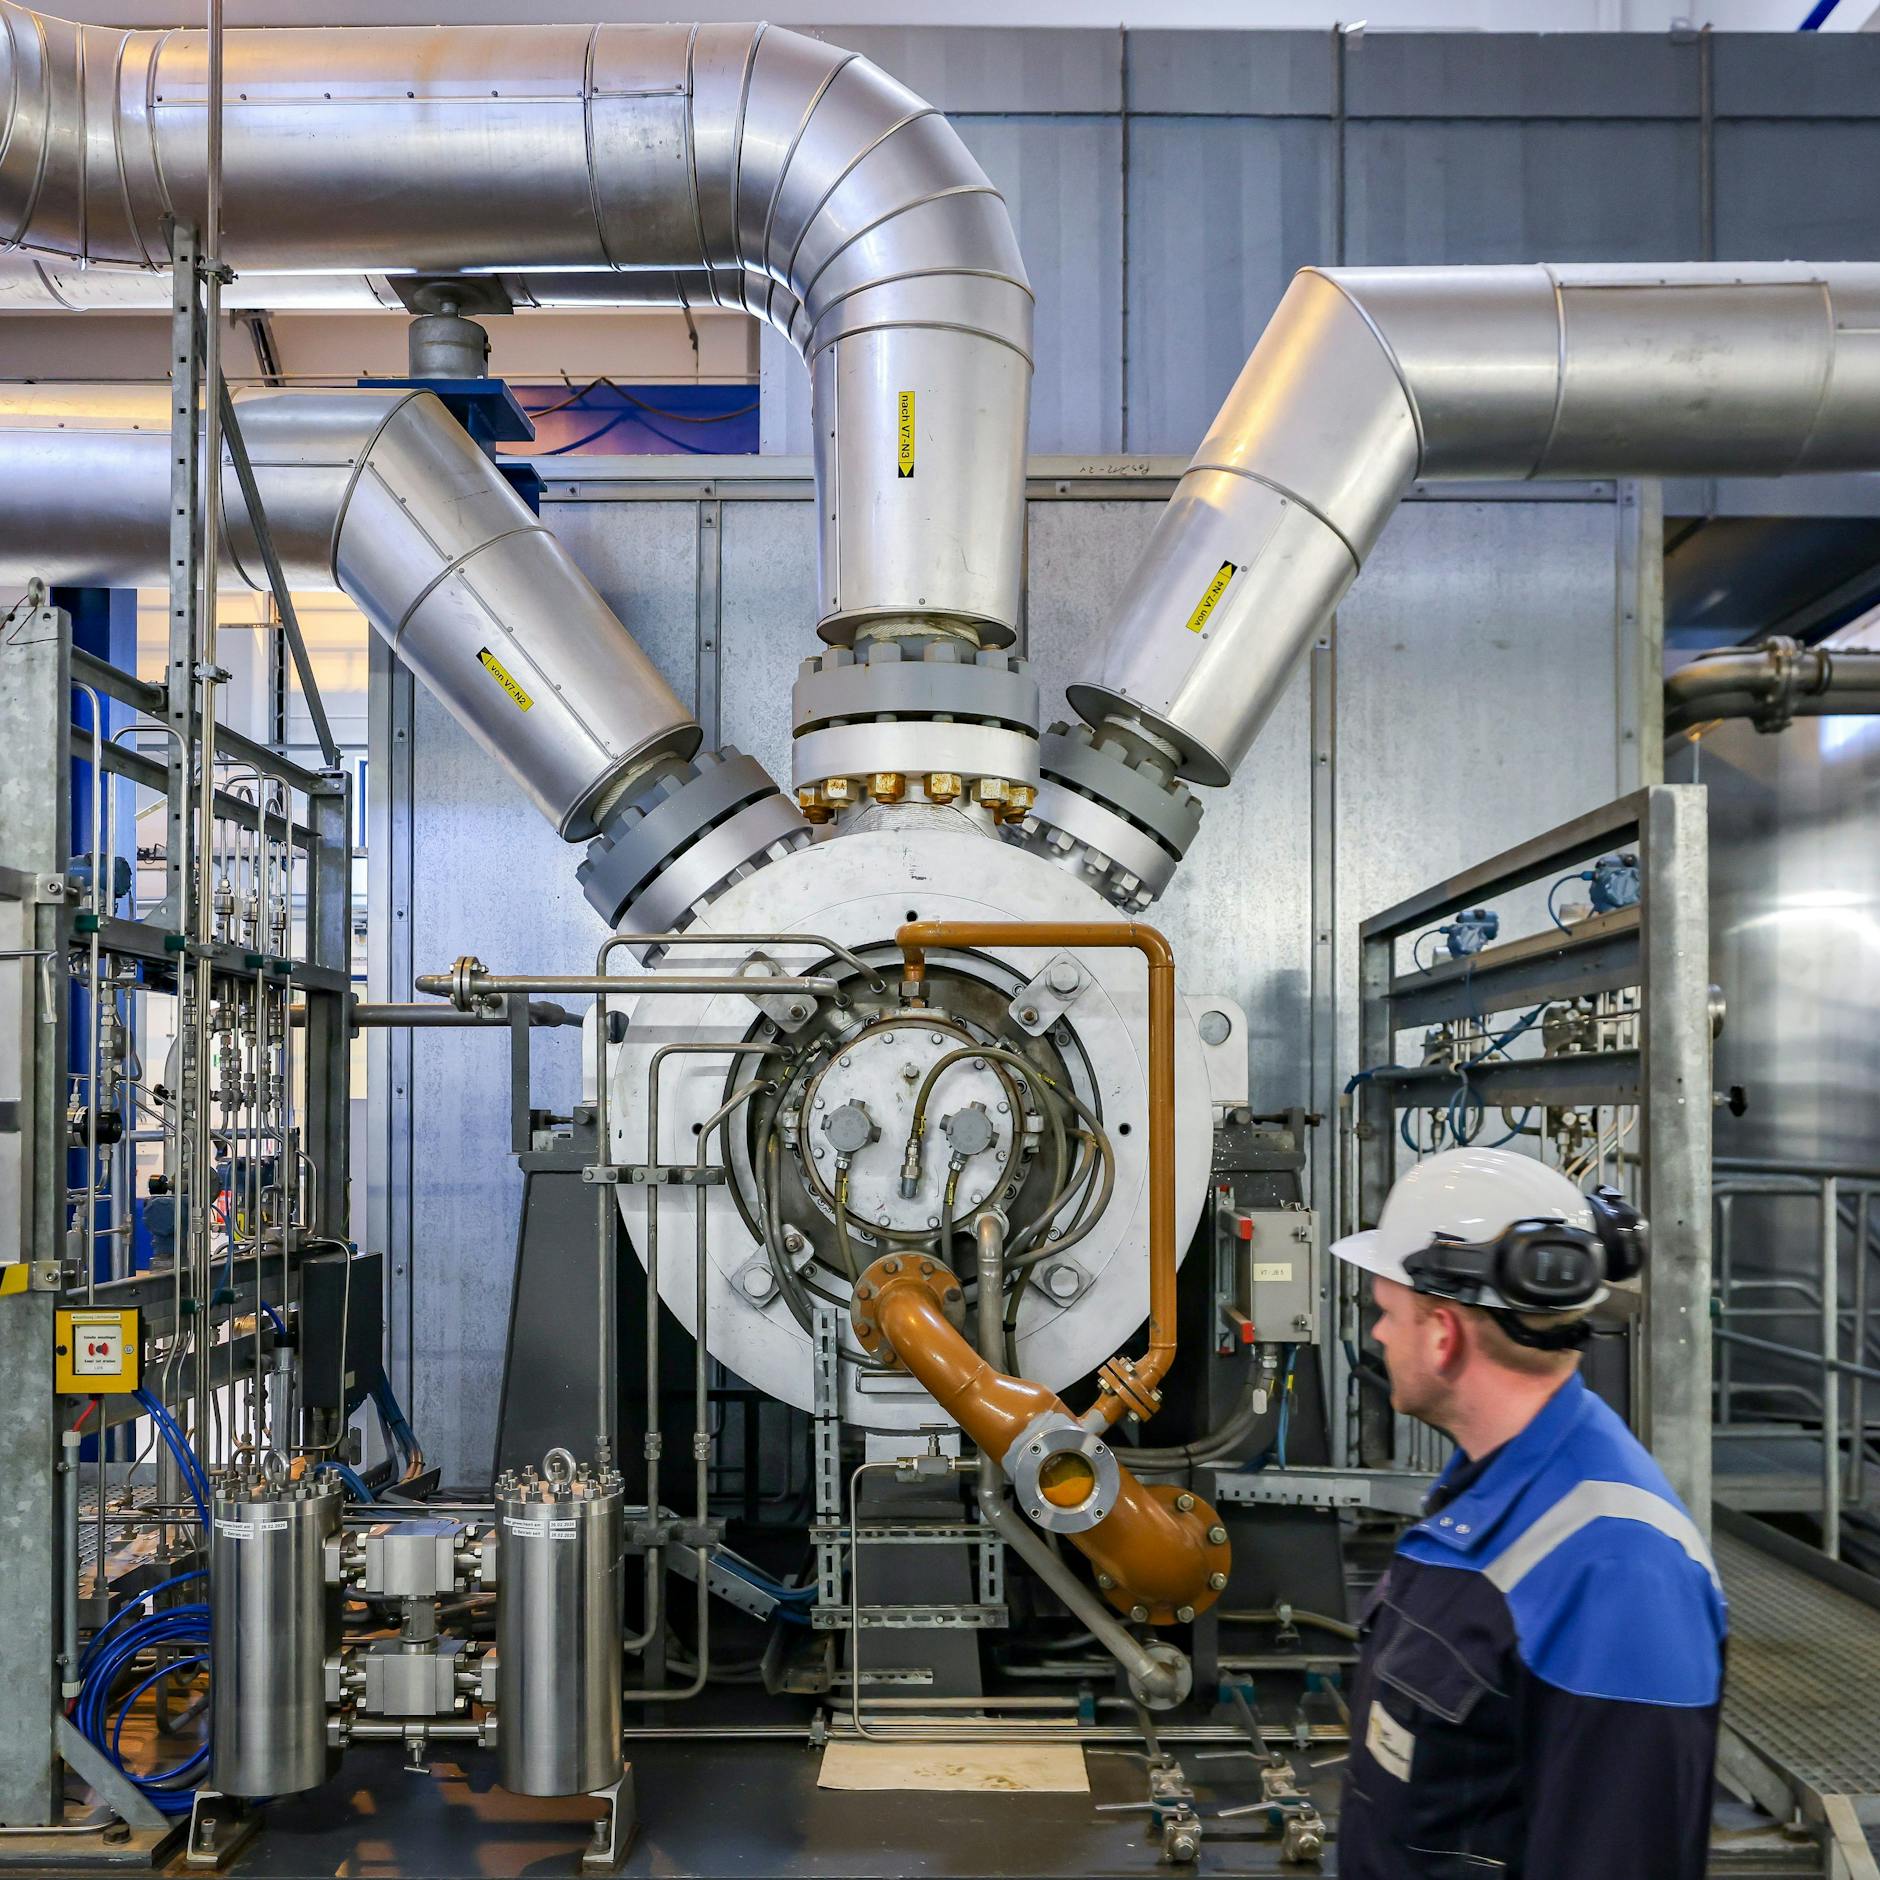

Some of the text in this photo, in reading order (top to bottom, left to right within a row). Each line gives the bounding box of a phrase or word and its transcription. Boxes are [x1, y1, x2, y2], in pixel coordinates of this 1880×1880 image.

[901, 395, 910, 459] nach V7-N3
[1195, 581, 1224, 626] von V7-N4
[491, 665, 526, 705] von V7-N2
